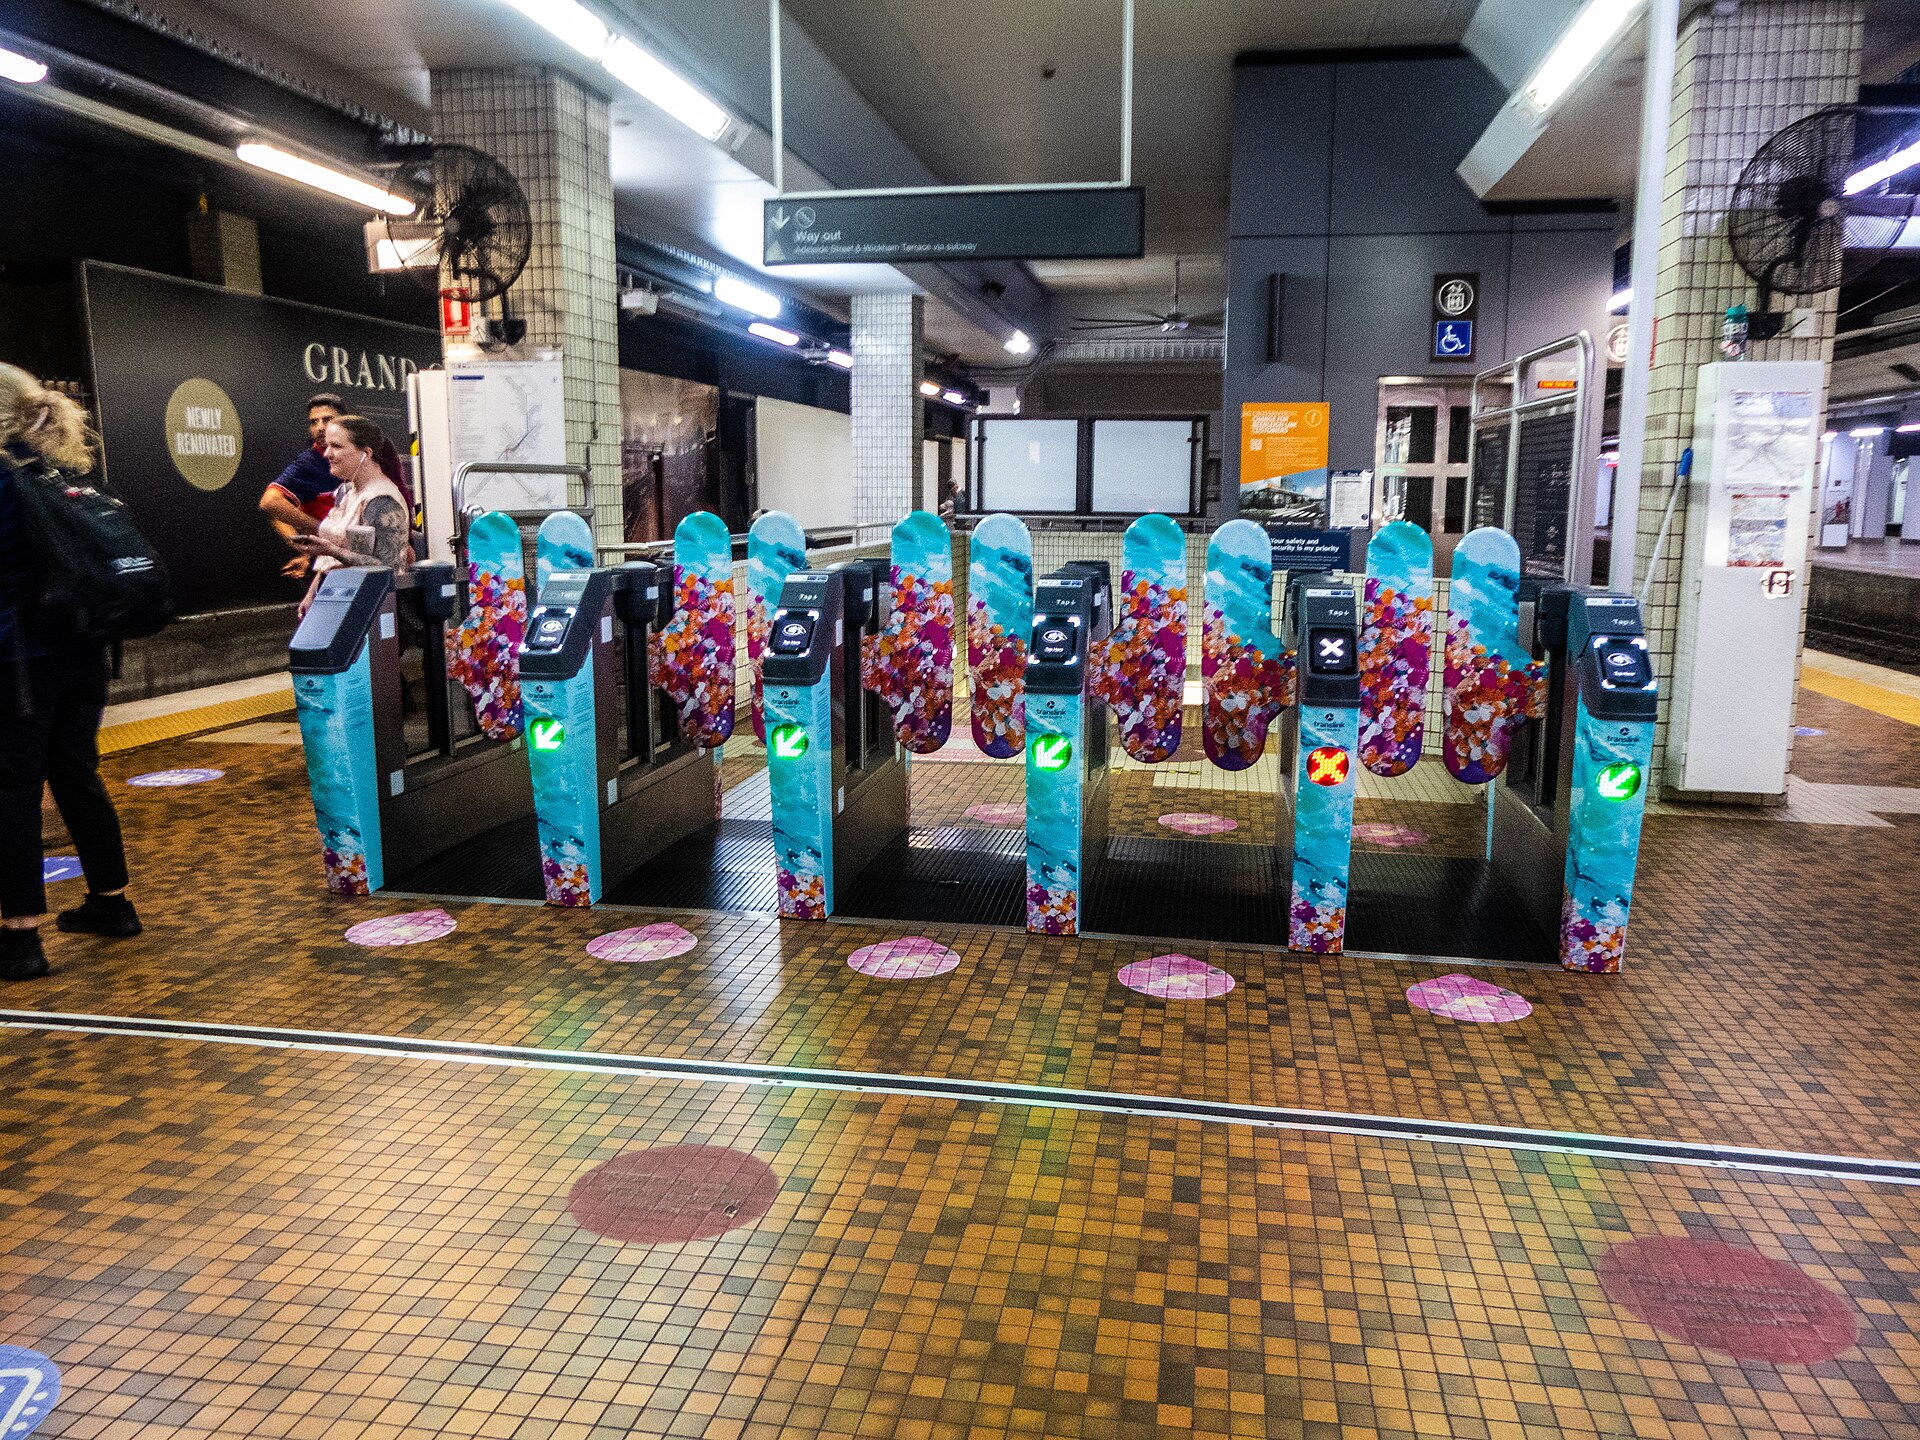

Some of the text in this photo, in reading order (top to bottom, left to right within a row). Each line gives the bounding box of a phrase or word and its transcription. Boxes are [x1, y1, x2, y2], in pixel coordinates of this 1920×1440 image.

[795, 230, 842, 245] Way out
[831, 243, 854, 252] Street
[902, 242, 931, 252] Terrace
[933, 242, 944, 251] via
[946, 242, 978, 252] subway
[303, 342, 417, 392] GRAND
[185, 405, 222, 430] NEWLY
[175, 431, 237, 458] RENOVATED
[1271, 537, 1285, 545] Your
[1286, 537, 1306, 546] safety
[1315, 545, 1340, 553] priority
[799, 593, 813, 601] Tap
[1328, 609, 1344, 617] Tap
[771, 697, 800, 705] translink
[1036, 708, 1067, 716] translink
[1313, 720, 1345, 728] translink
[1606, 735, 1640, 743] translink
